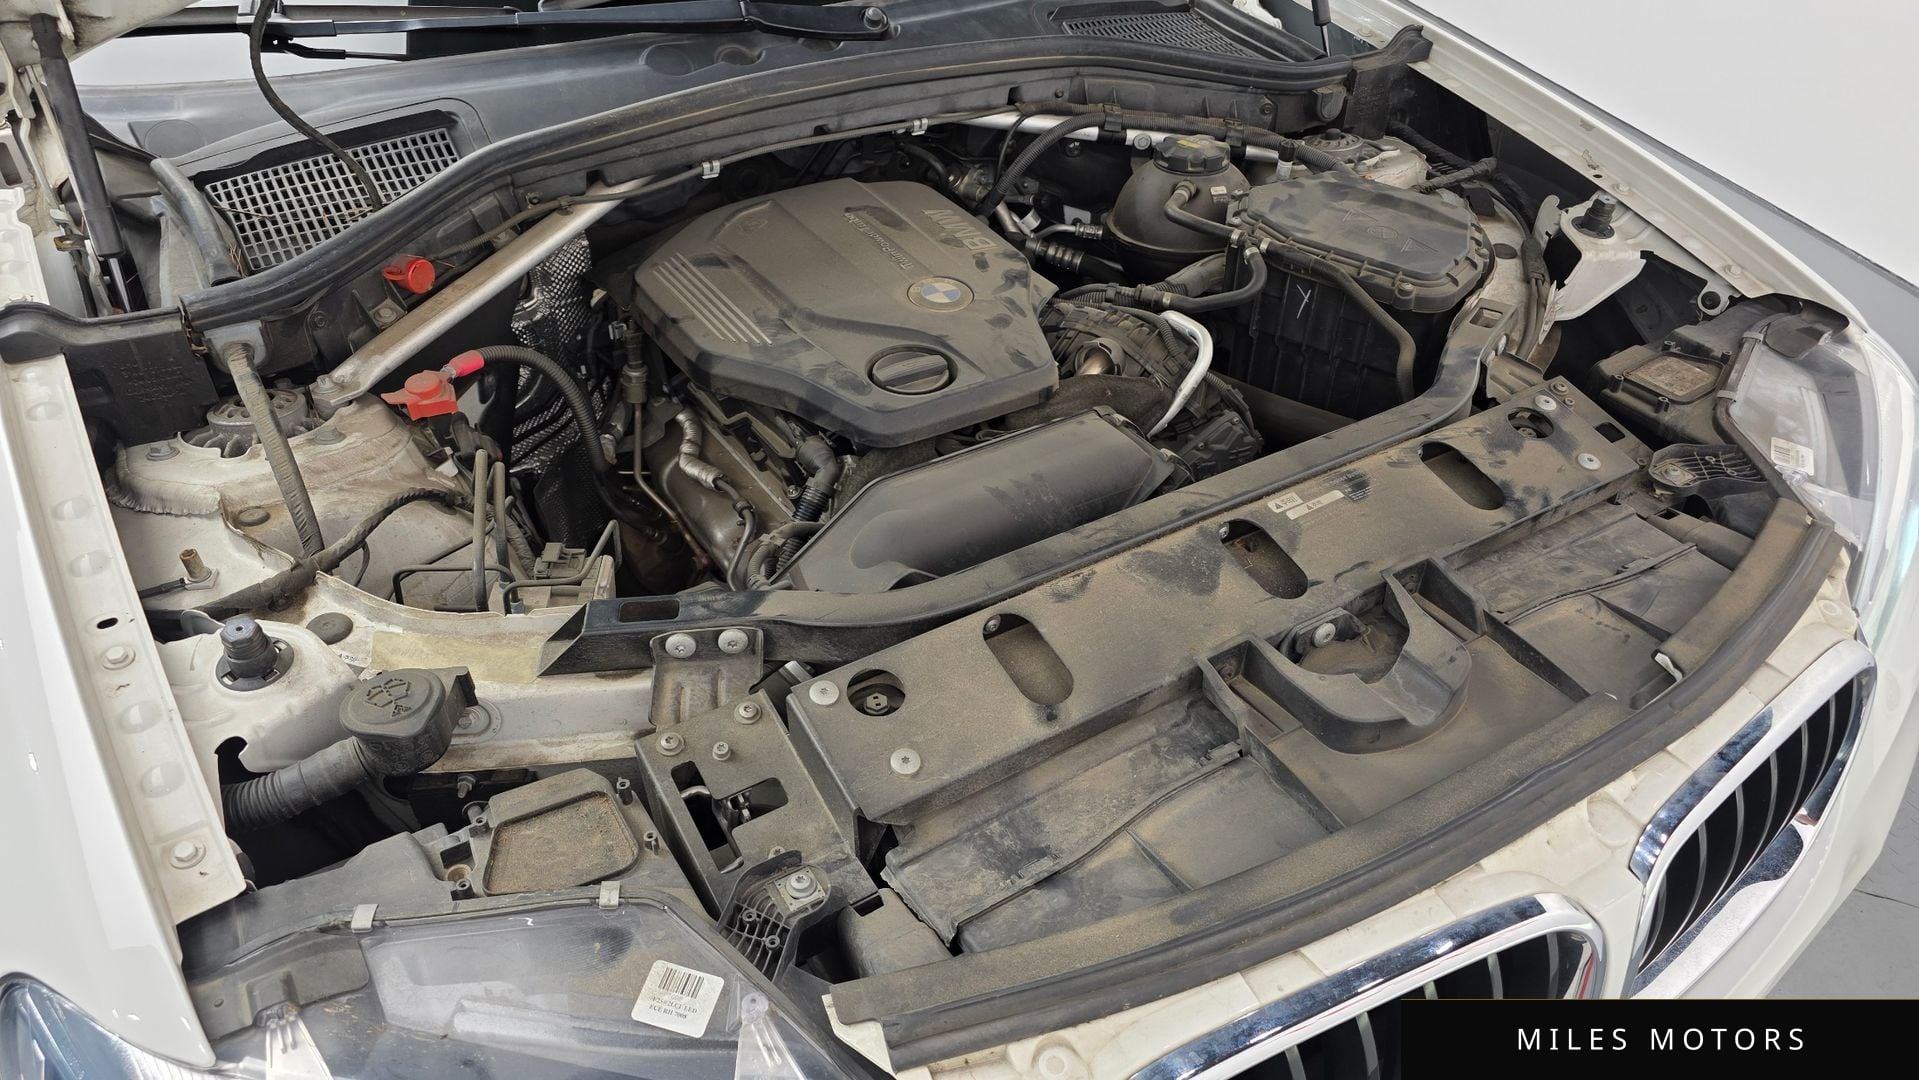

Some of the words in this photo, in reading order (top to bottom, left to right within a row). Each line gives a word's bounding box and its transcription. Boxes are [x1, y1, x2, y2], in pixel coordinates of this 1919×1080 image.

[843, 211, 868, 234] Turbo
[921, 209, 997, 250] BMW
[866, 229, 913, 270] TwinPower
